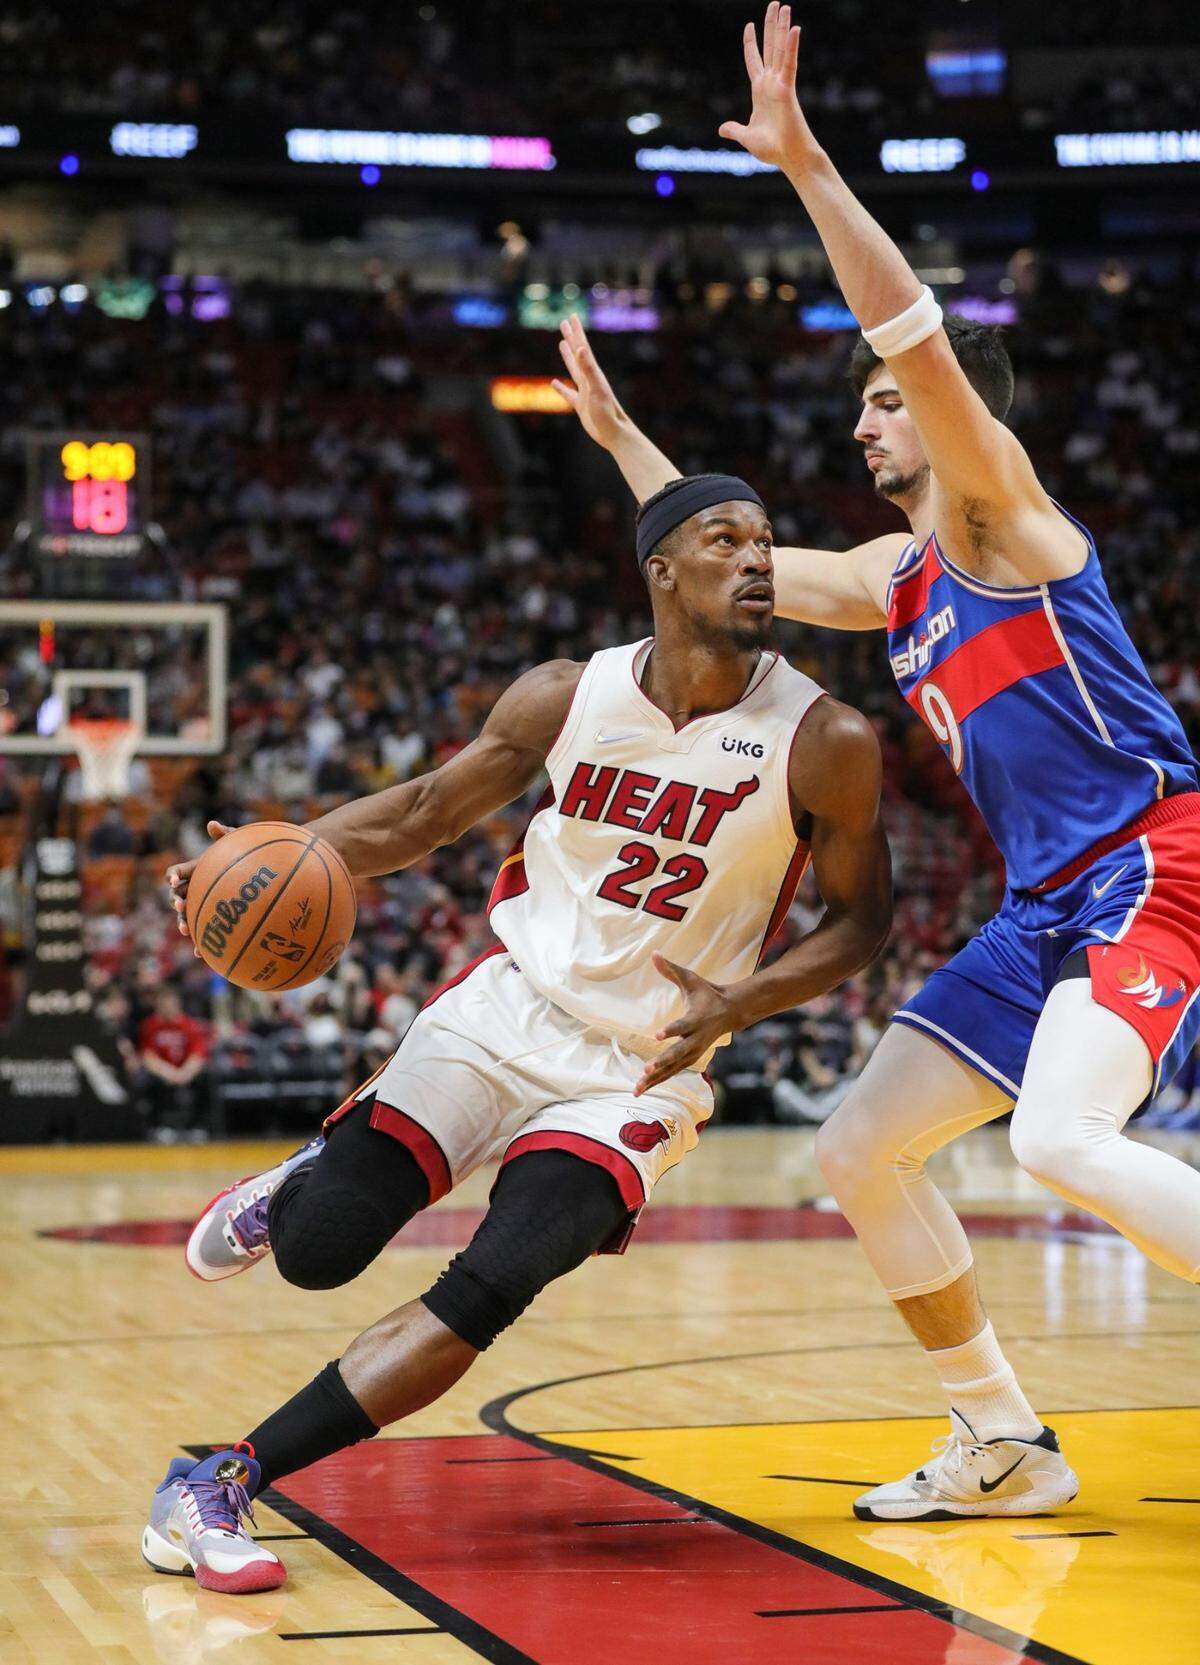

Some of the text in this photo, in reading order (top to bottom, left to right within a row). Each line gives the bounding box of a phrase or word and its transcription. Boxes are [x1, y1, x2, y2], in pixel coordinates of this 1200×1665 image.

[918, 680, 963, 776] 9
[558, 762, 760, 848] HEAT
[202, 865, 279, 957] Wilson
[596, 840, 708, 922] 22
